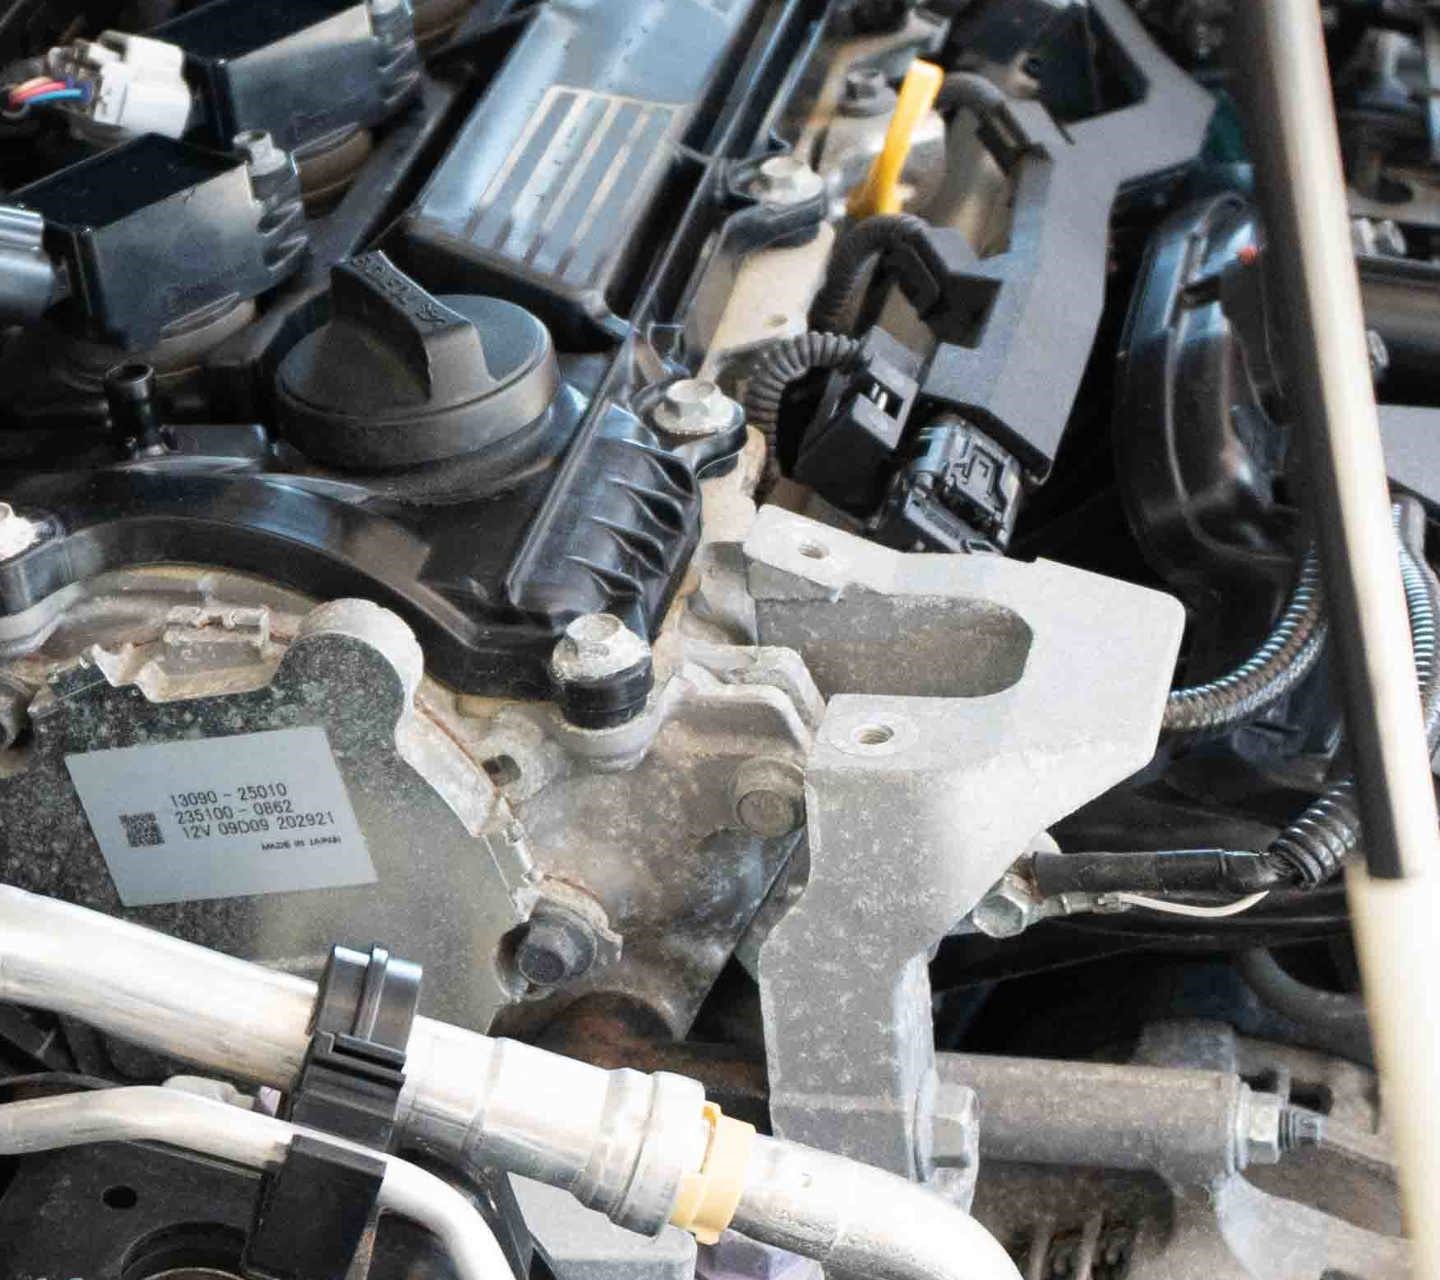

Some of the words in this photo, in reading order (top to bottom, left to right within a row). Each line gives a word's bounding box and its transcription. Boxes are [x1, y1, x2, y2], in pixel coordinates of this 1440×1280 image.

[170, 789, 218, 809] 13090
[238, 782, 288, 802] 25010
[175, 805, 235, 825] 235100
[252, 799, 294, 817] 0862
[182, 824, 212, 840] 12V
[275, 811, 336, 830] 202921
[261, 840, 292, 851] MADE
